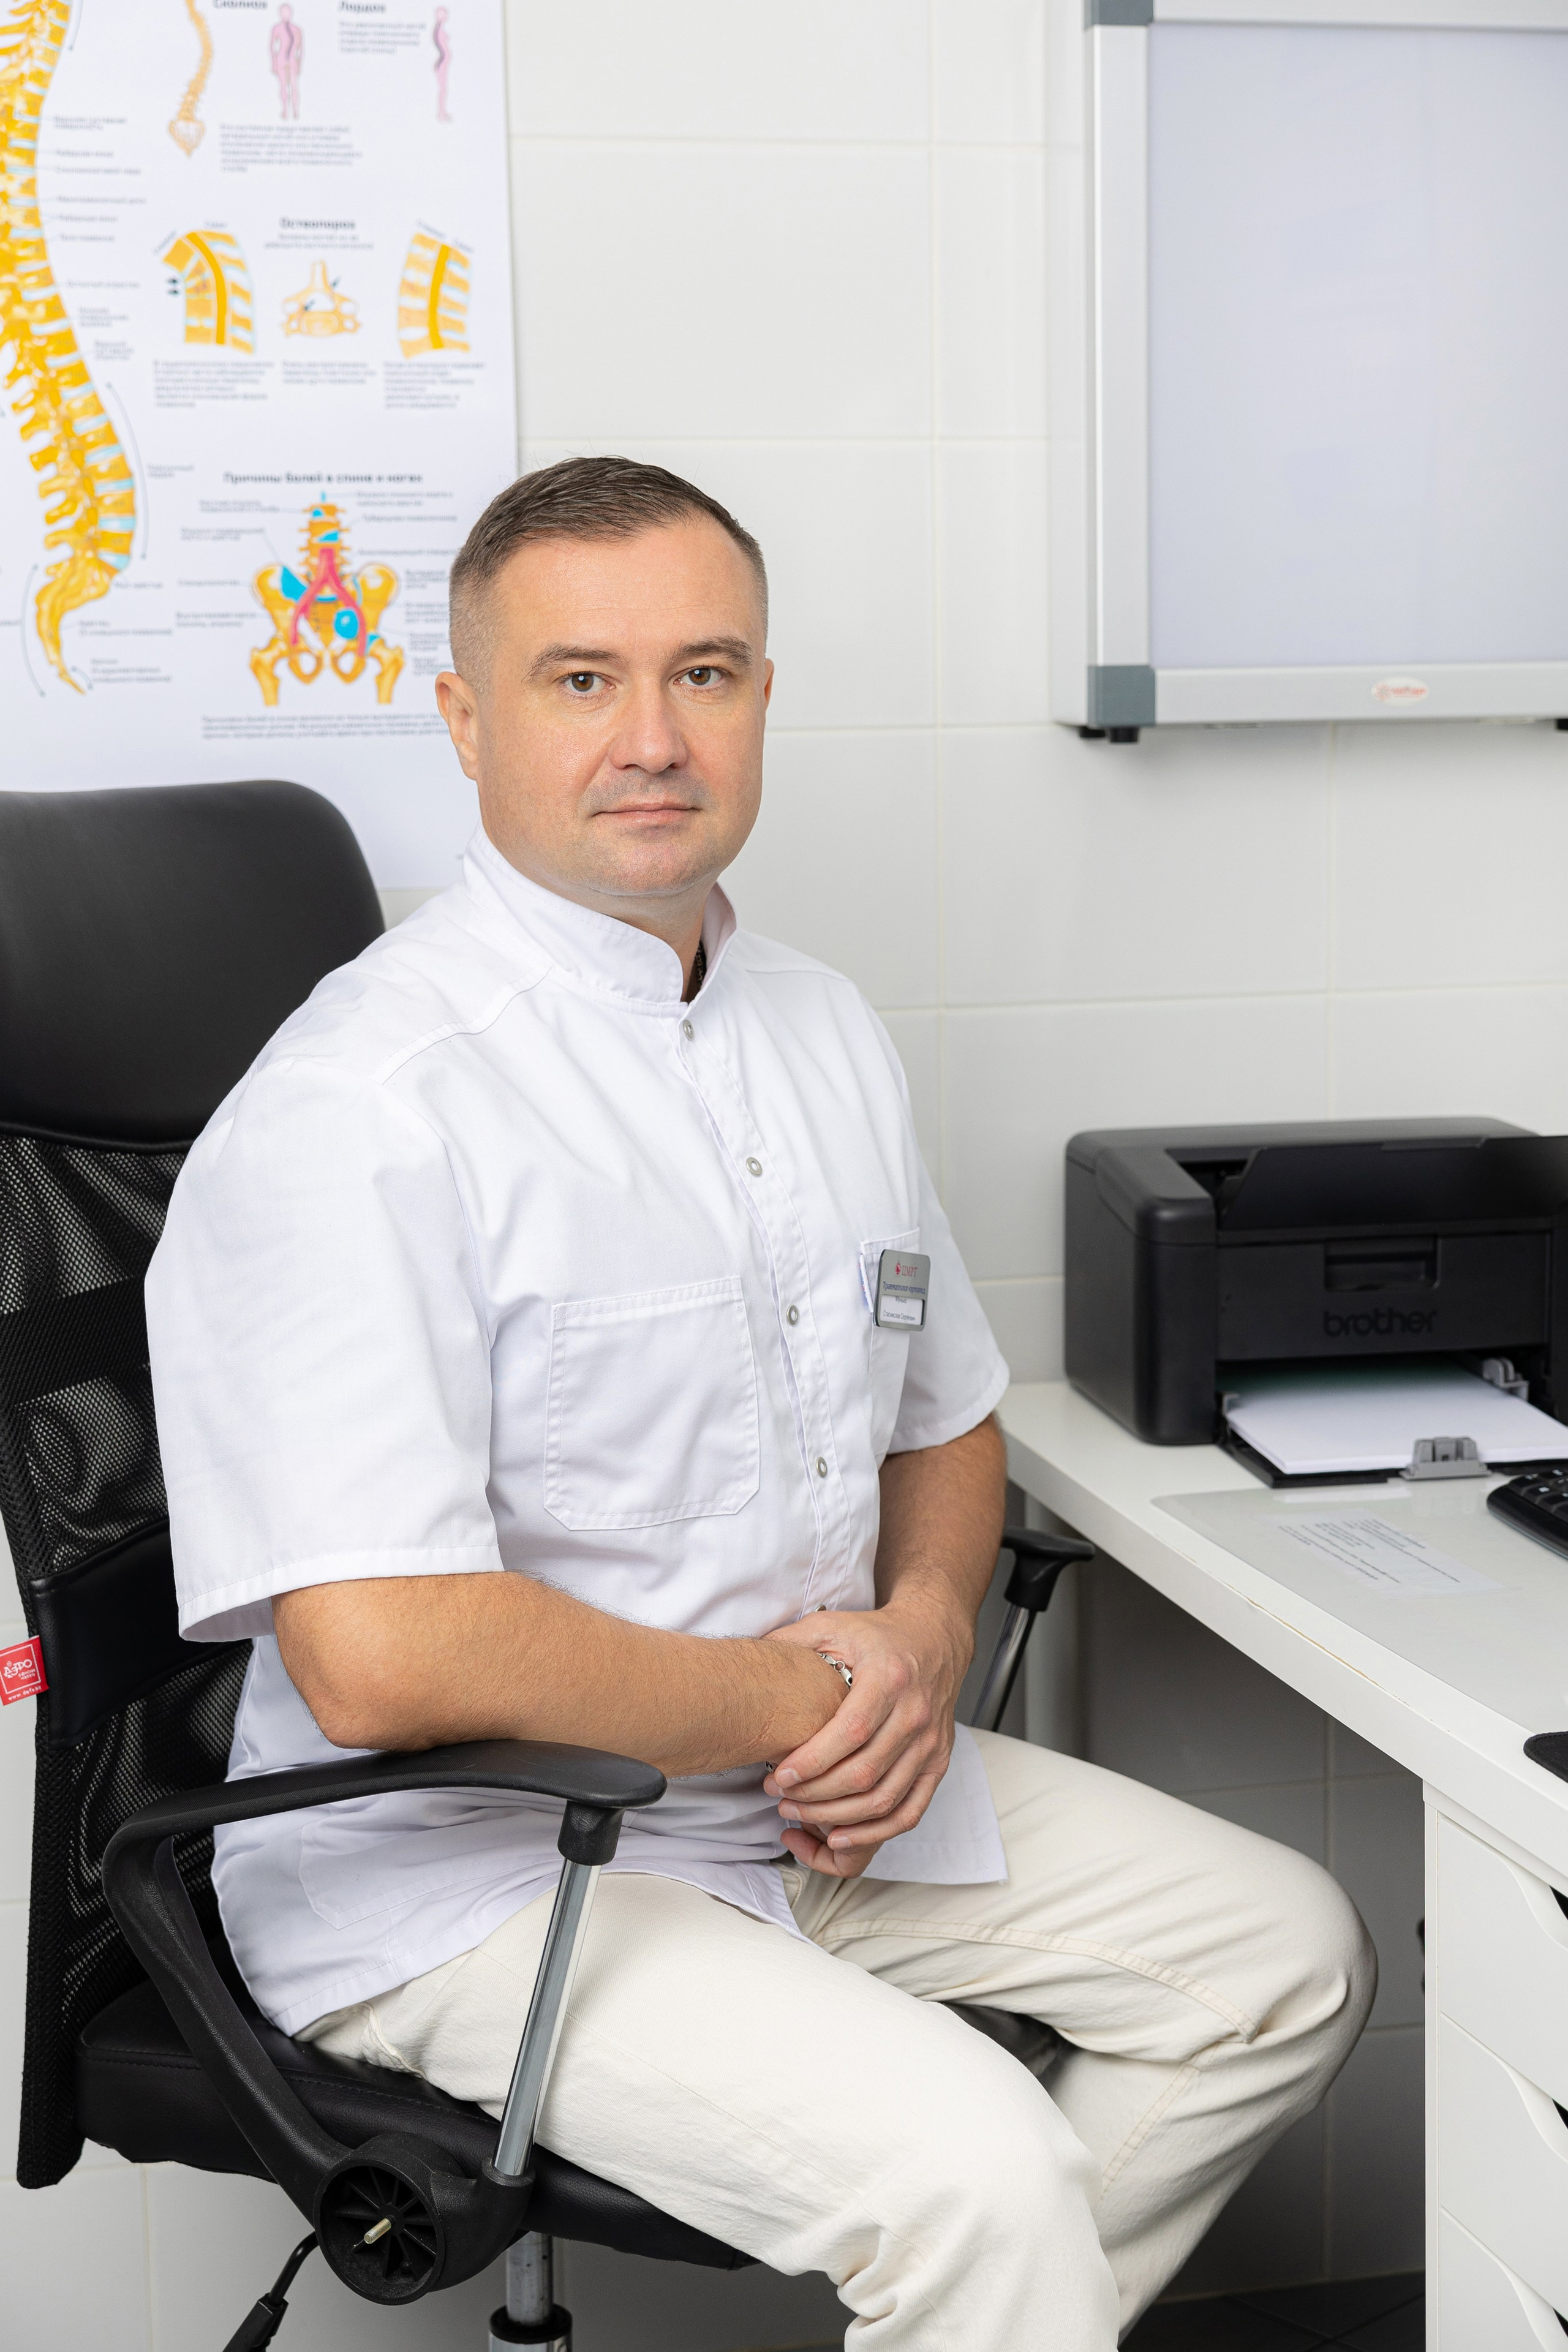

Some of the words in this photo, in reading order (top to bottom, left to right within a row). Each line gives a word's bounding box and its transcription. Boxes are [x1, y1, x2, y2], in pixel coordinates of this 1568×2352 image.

[224, 471, 281, 484] Причины
[285, 470, 323, 483] болей
[387, 474, 423, 483] ногах
[1323, 1307, 1437, 1336] brother
